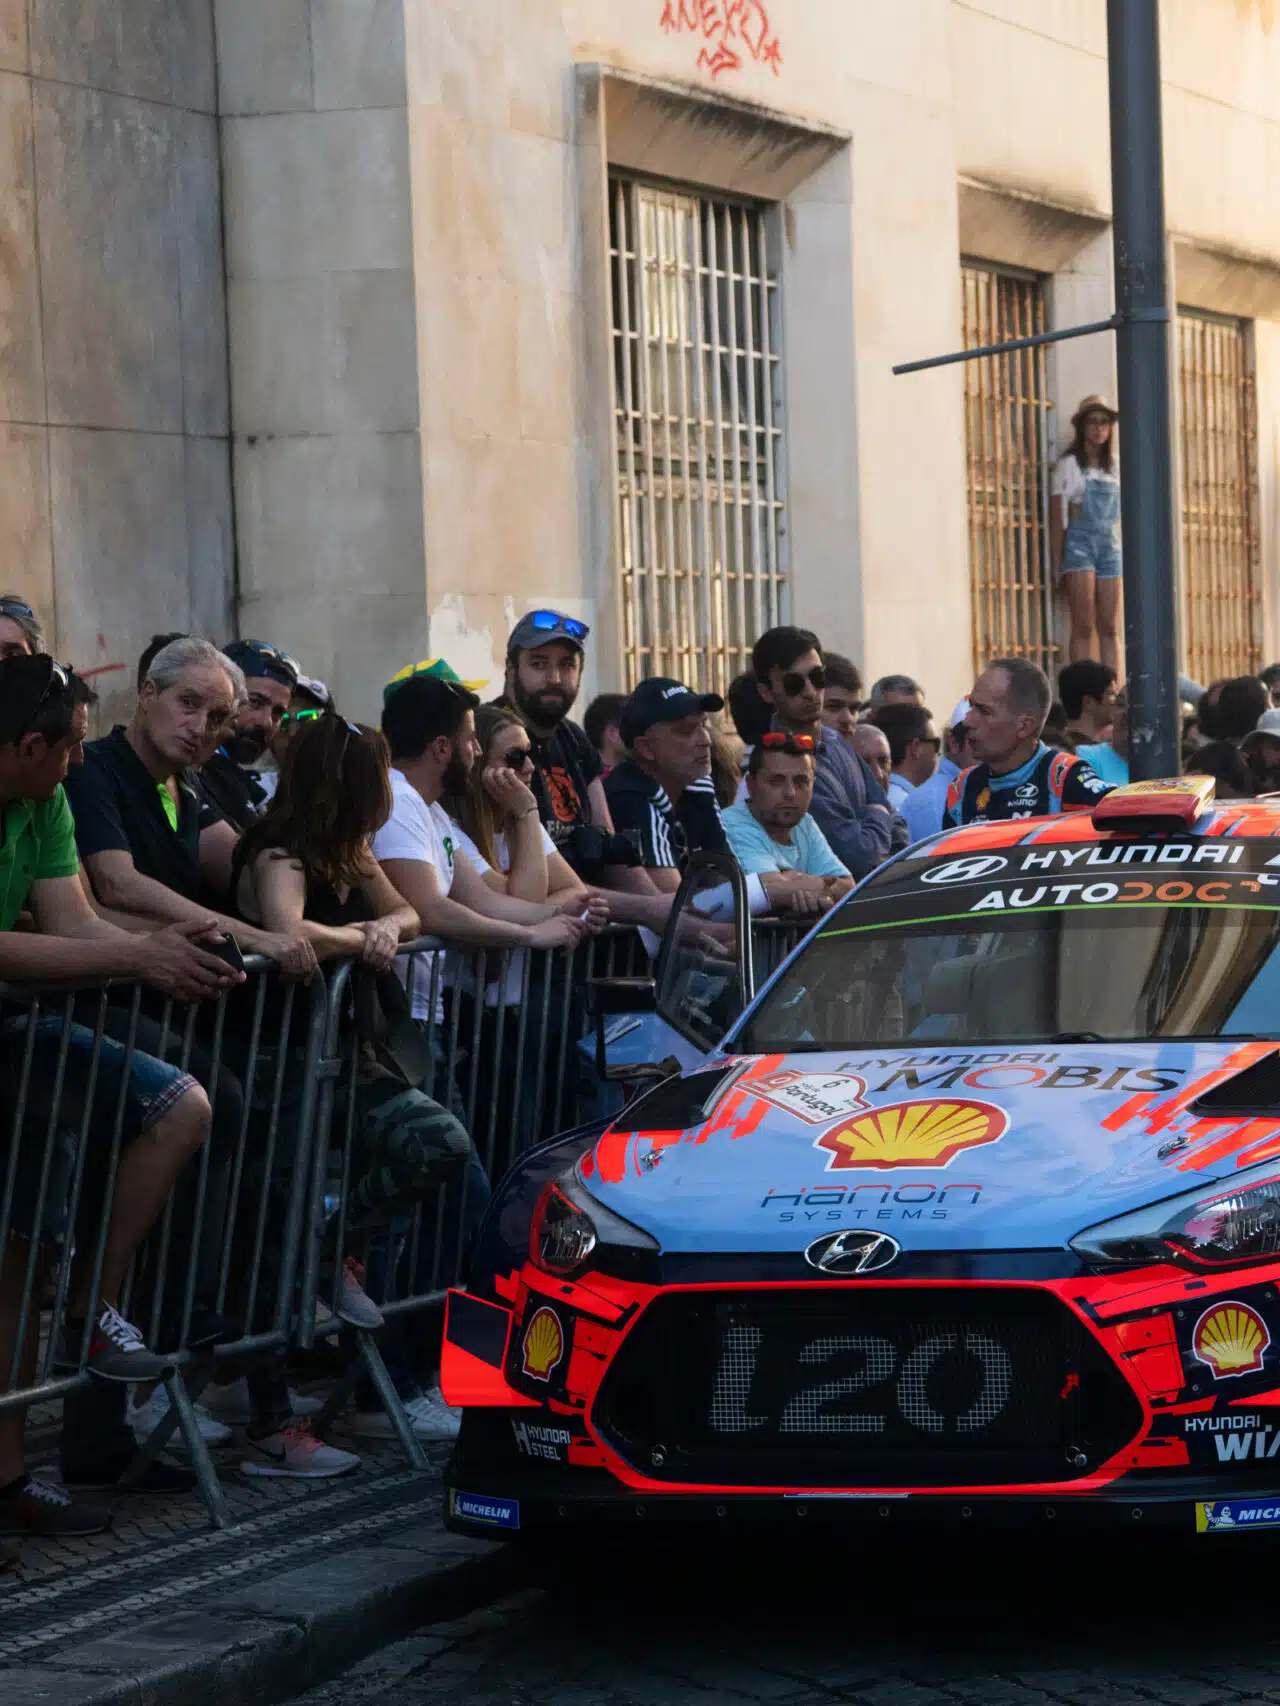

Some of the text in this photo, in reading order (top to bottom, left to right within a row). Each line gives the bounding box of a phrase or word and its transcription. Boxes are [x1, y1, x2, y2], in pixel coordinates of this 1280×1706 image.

[1020, 845, 1245, 871] HYUNDAI
[969, 880, 1232, 912] AUTODOC
[834, 1051, 1061, 1074] HYUNDAI
[872, 1064, 1187, 1093] MOBIS
[779, 1084, 845, 1117] Portugal
[778, 1208, 948, 1223] SYSTEMS
[527, 1424, 572, 1445] HYUNDAI
[1184, 1414, 1262, 1433] HYUNDAI
[531, 1442, 562, 1461] STEEL
[462, 1501, 511, 1520] MICHELIN
